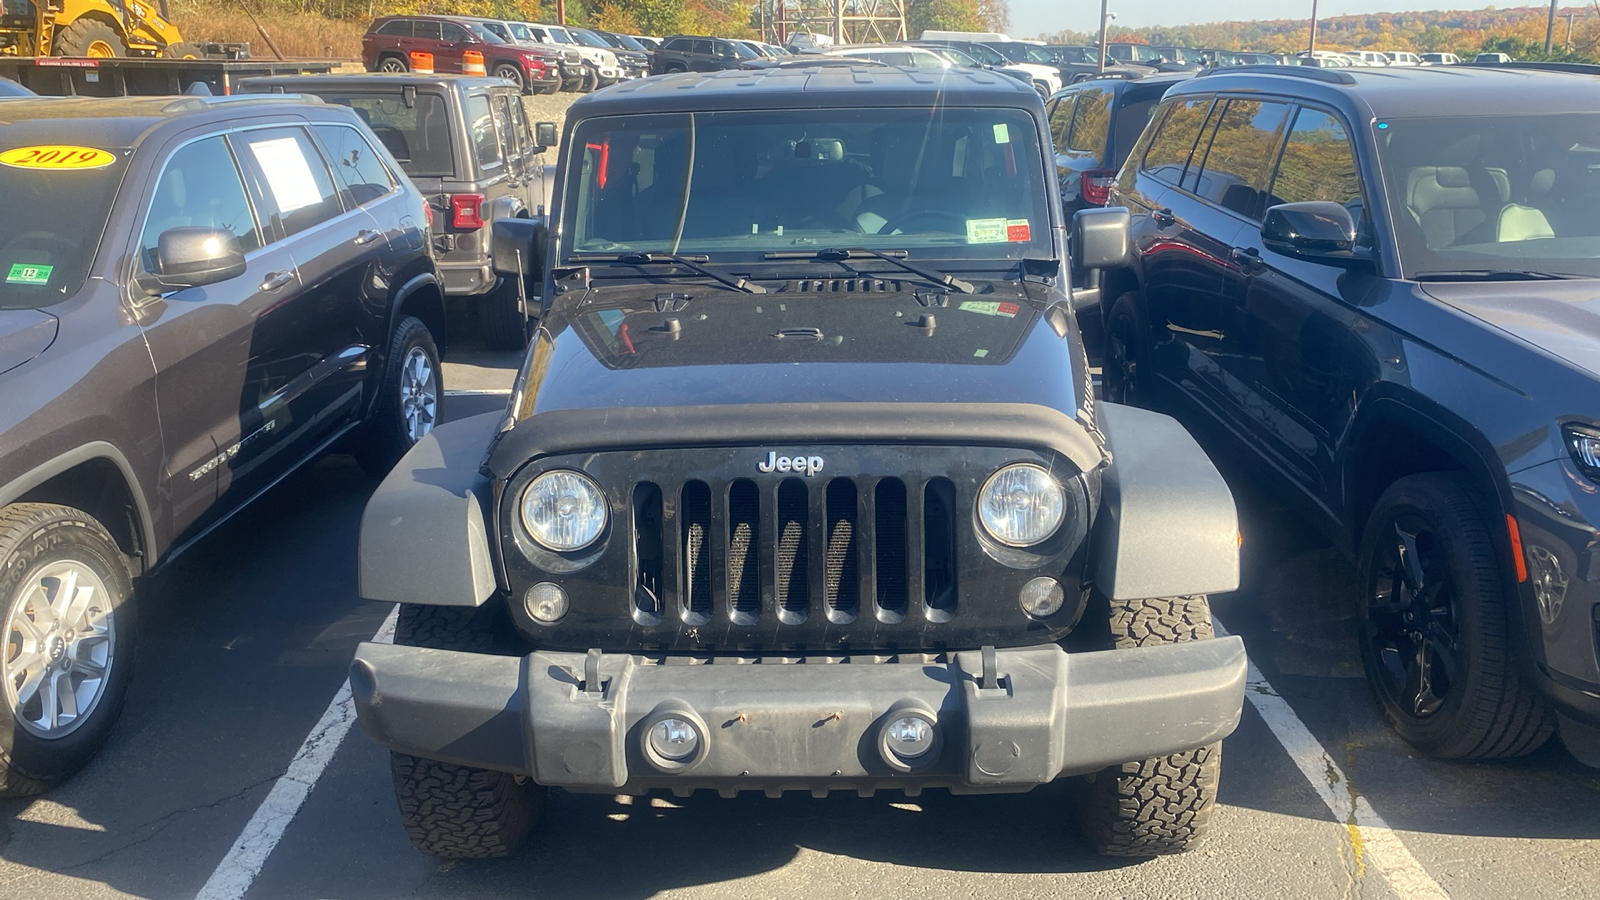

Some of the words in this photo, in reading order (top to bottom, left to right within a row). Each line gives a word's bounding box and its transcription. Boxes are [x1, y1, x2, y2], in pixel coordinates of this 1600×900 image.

[13, 150, 98, 164] 2019
[24, 269, 35, 277] 12
[758, 451, 823, 477] Jeep
